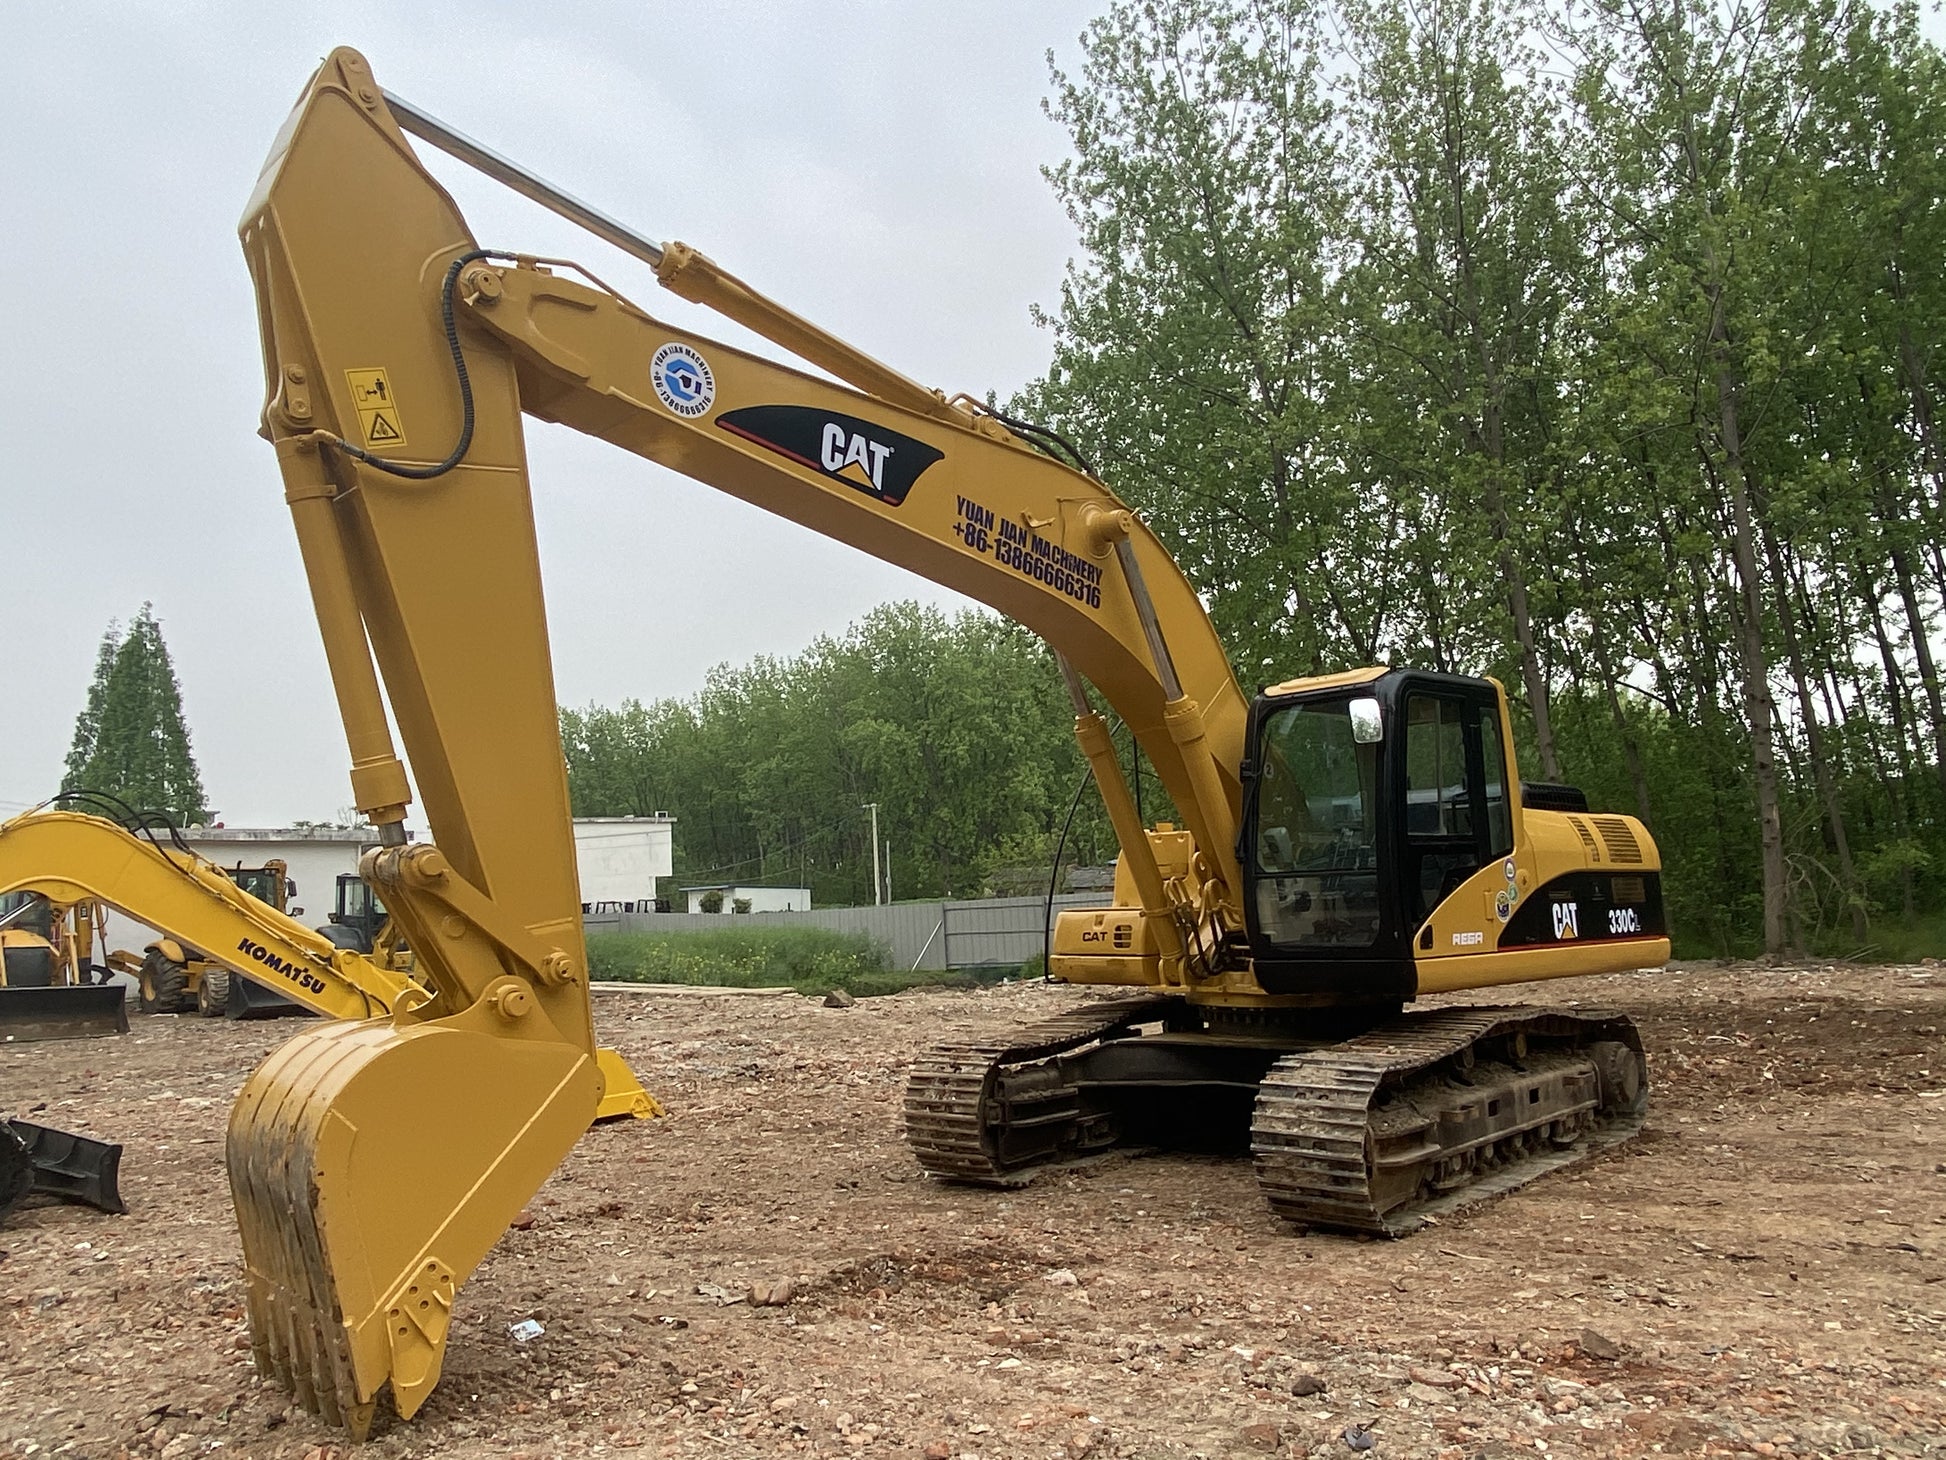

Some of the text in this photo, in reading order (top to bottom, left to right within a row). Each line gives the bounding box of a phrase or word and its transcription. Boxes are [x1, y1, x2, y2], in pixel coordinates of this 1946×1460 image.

[654, 348, 669, 367] YUAN
[684, 348, 714, 392] MACHINERY
[820, 422, 892, 491] CAT
[952, 521, 1102, 610] +86-13866666316
[956, 494, 1104, 587] YUAN JIAN MACHINERY
[1082, 931, 1108, 942] CAT
[1552, 902, 1578, 940] CAT
[237, 937, 327, 994] KOMATSU
